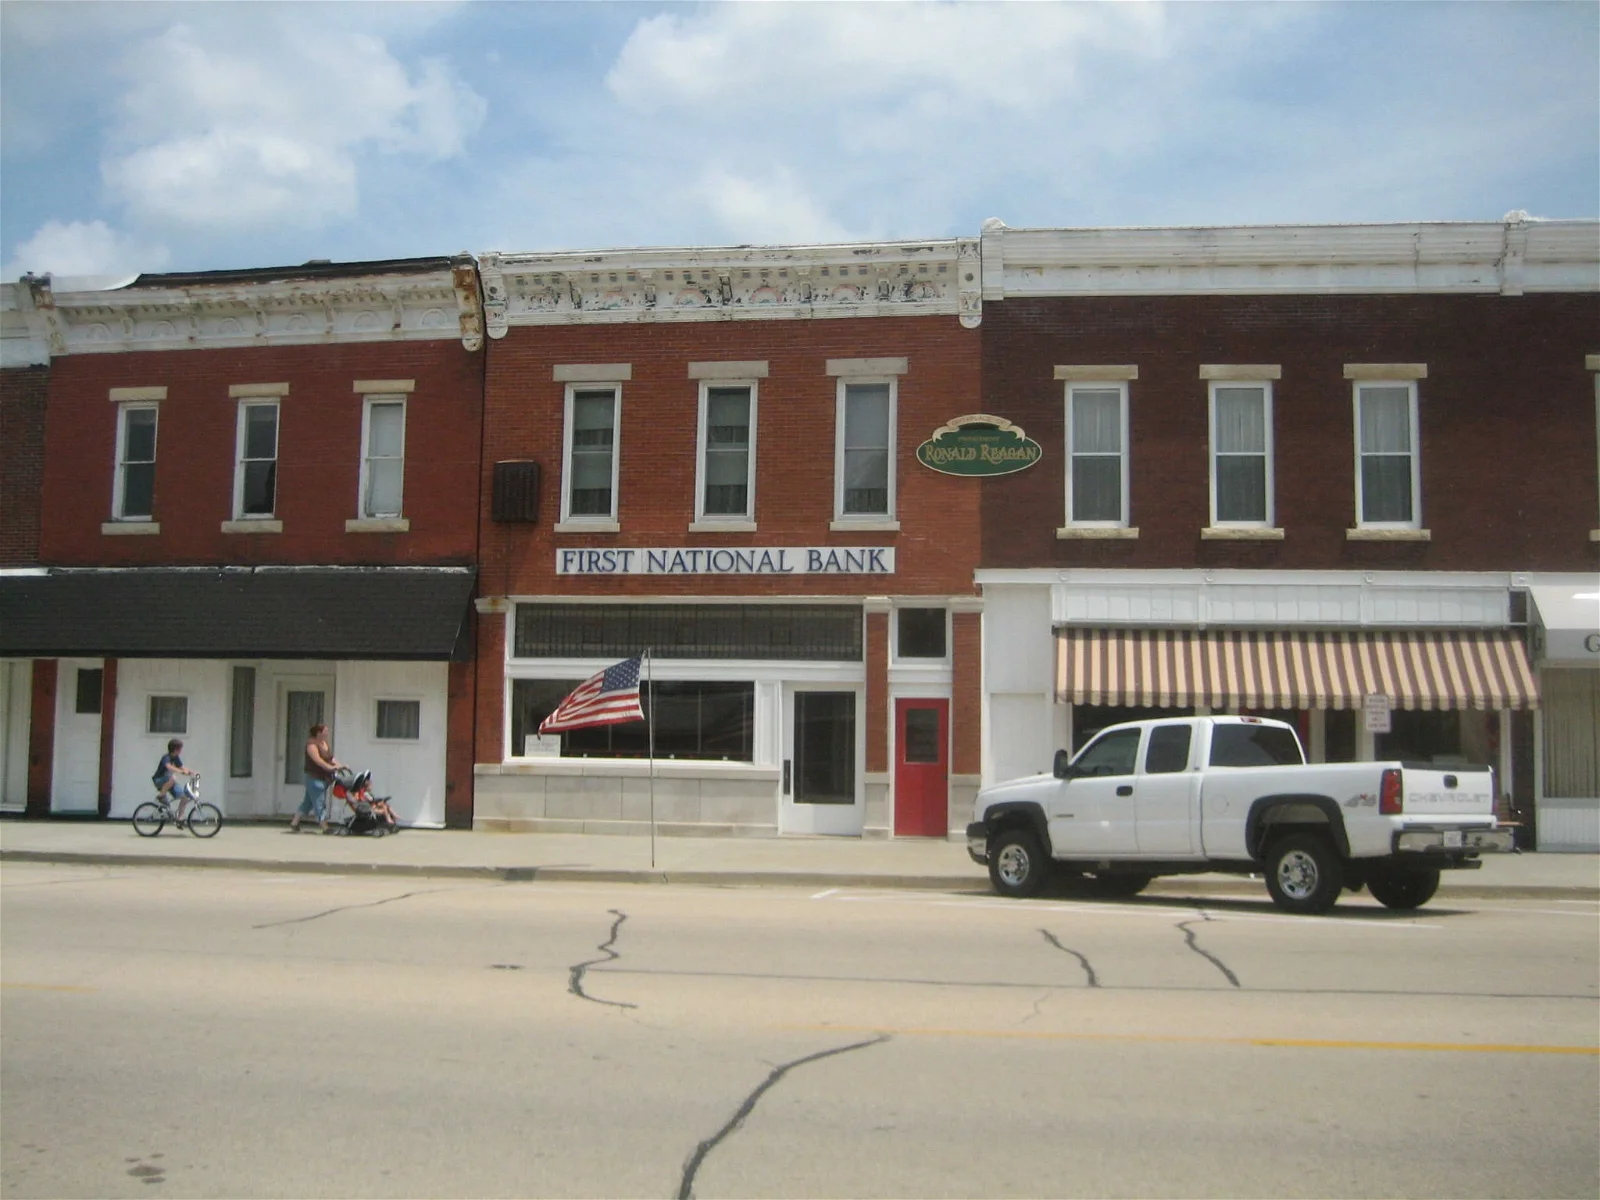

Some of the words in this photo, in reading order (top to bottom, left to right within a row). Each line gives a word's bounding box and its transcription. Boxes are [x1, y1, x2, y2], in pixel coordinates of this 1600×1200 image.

[925, 445, 977, 464] RONALD
[980, 444, 1037, 465] REAGAN
[562, 549, 635, 573] FIRST
[646, 549, 794, 573] NATIONAL
[808, 548, 889, 573] BANK
[1408, 792, 1490, 804] CHEVROLET
